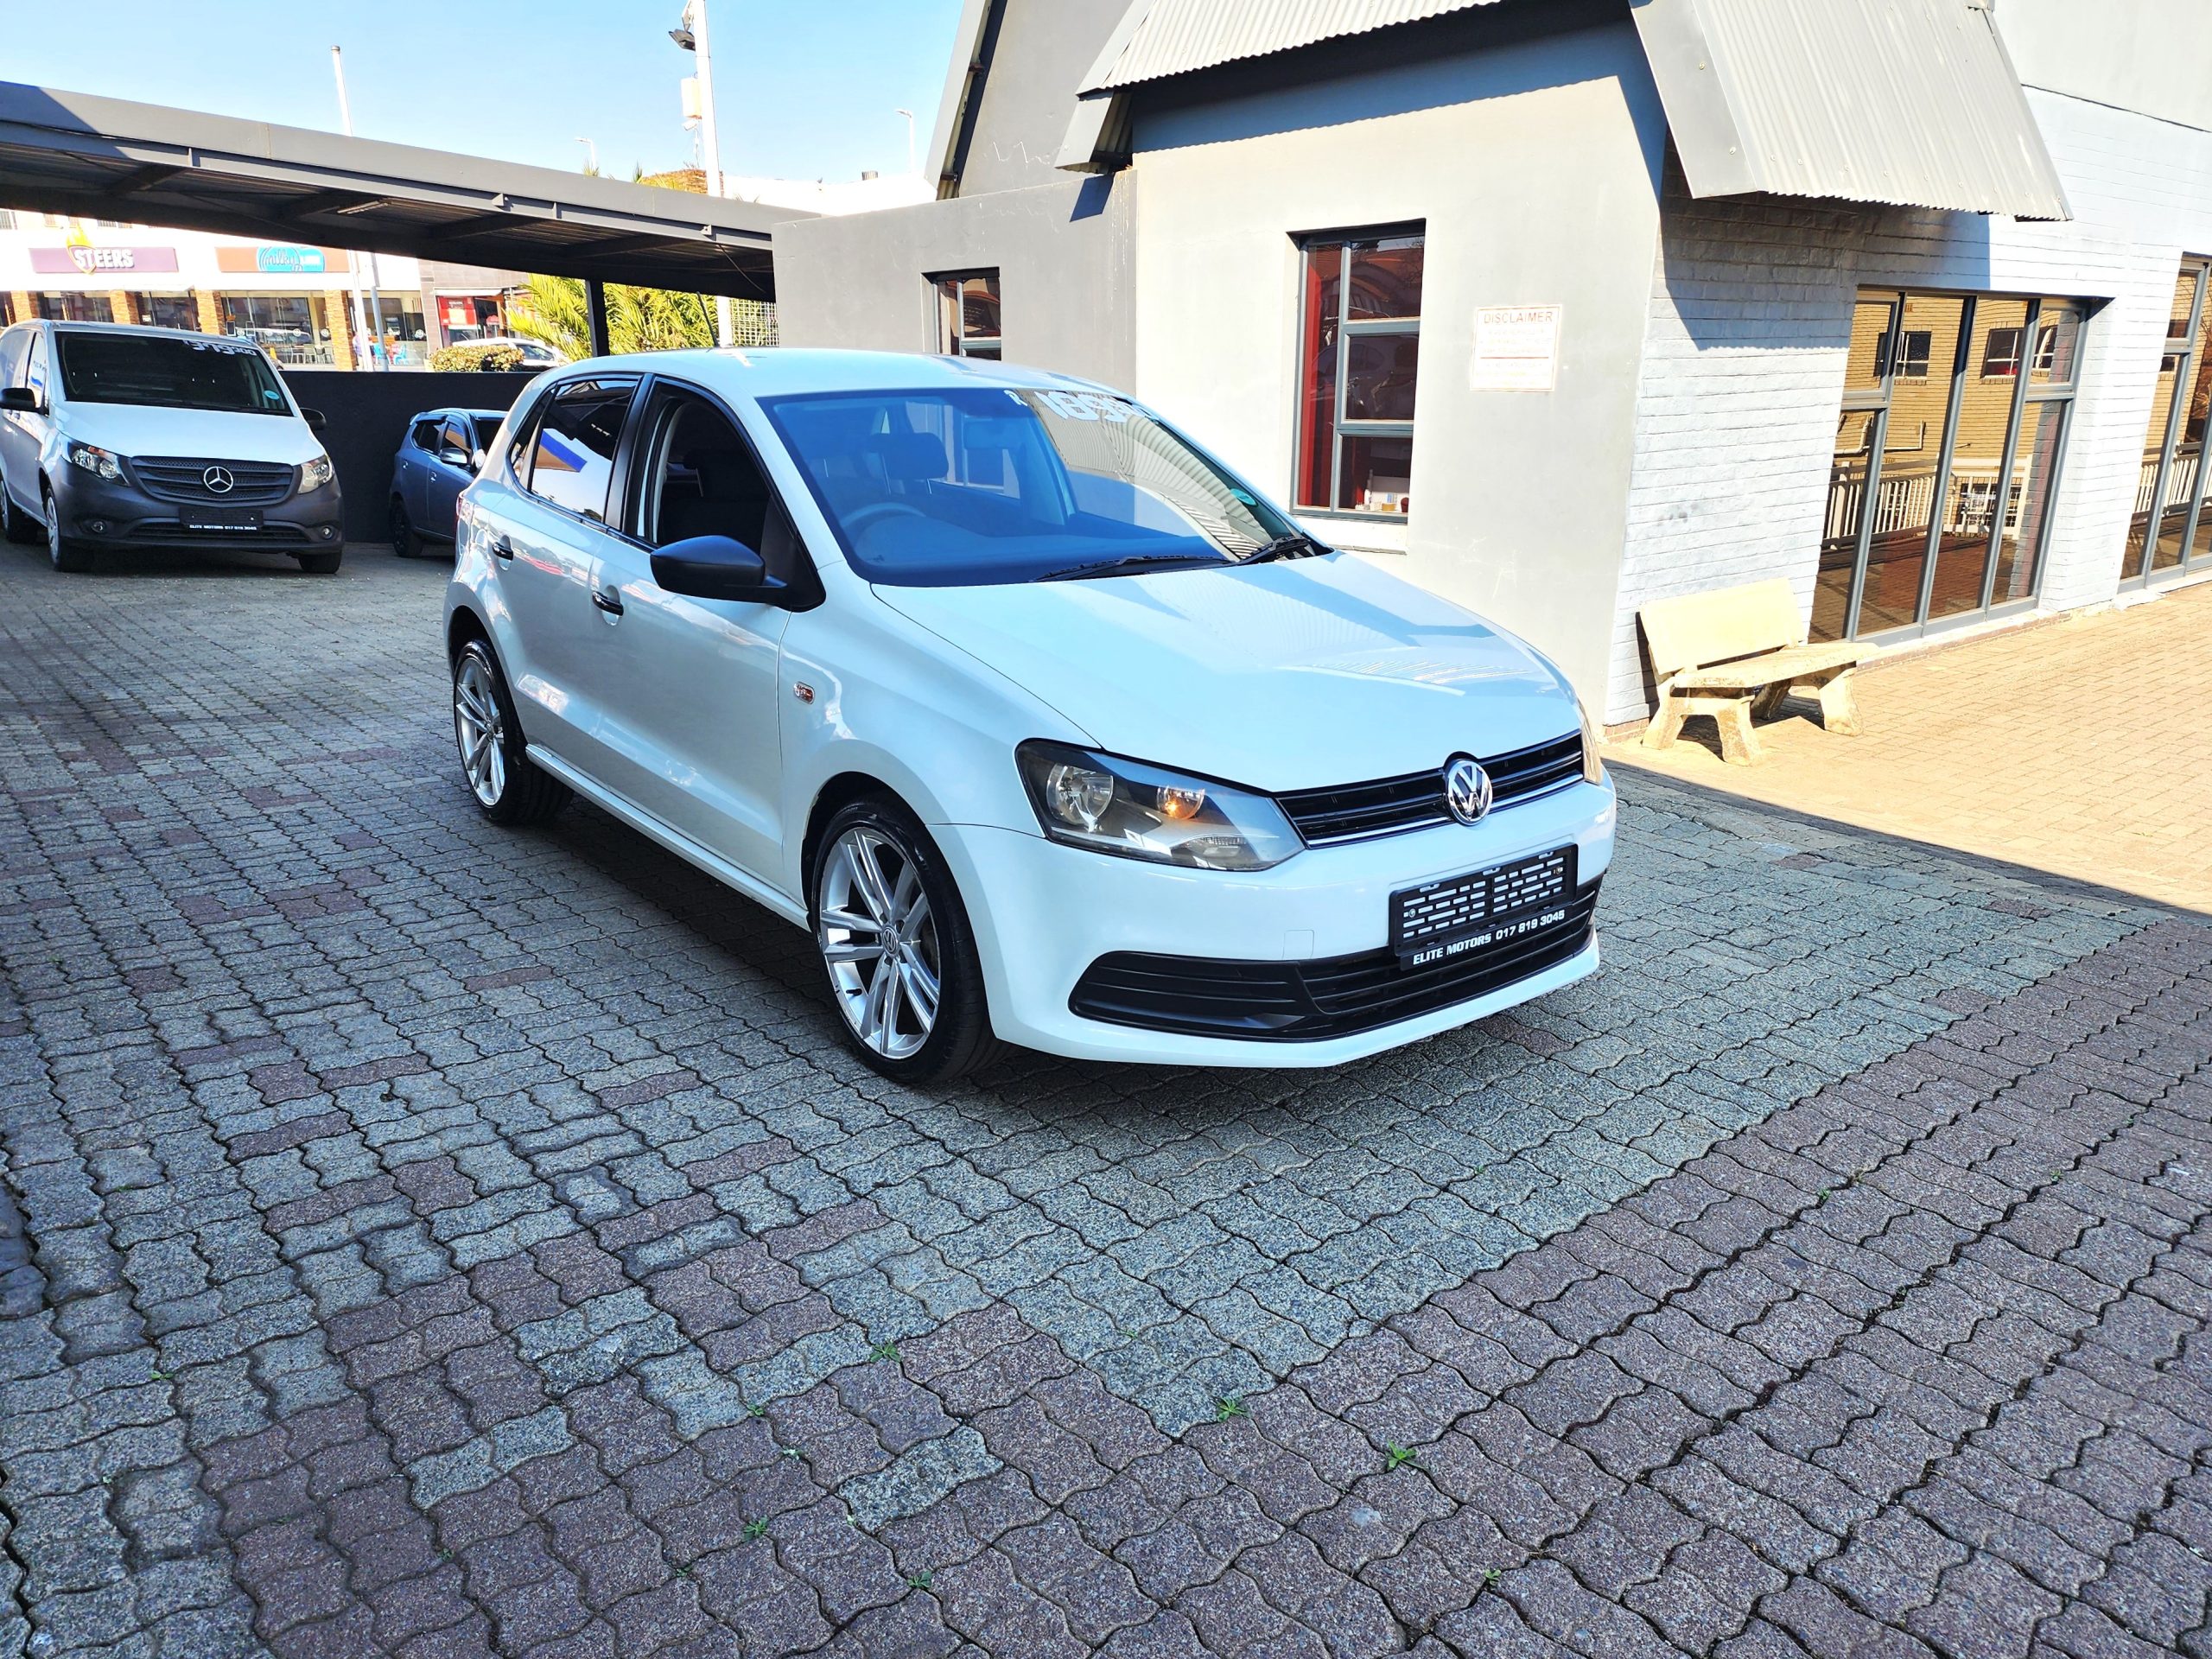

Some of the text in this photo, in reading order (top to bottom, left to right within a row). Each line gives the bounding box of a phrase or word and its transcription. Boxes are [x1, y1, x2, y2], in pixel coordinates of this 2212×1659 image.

[73, 249, 135, 269] STEERS
[1484, 311, 1553, 324] DISCLAIMER
[1413, 909, 1565, 965] ELITE MOTORS 017 819 3045
